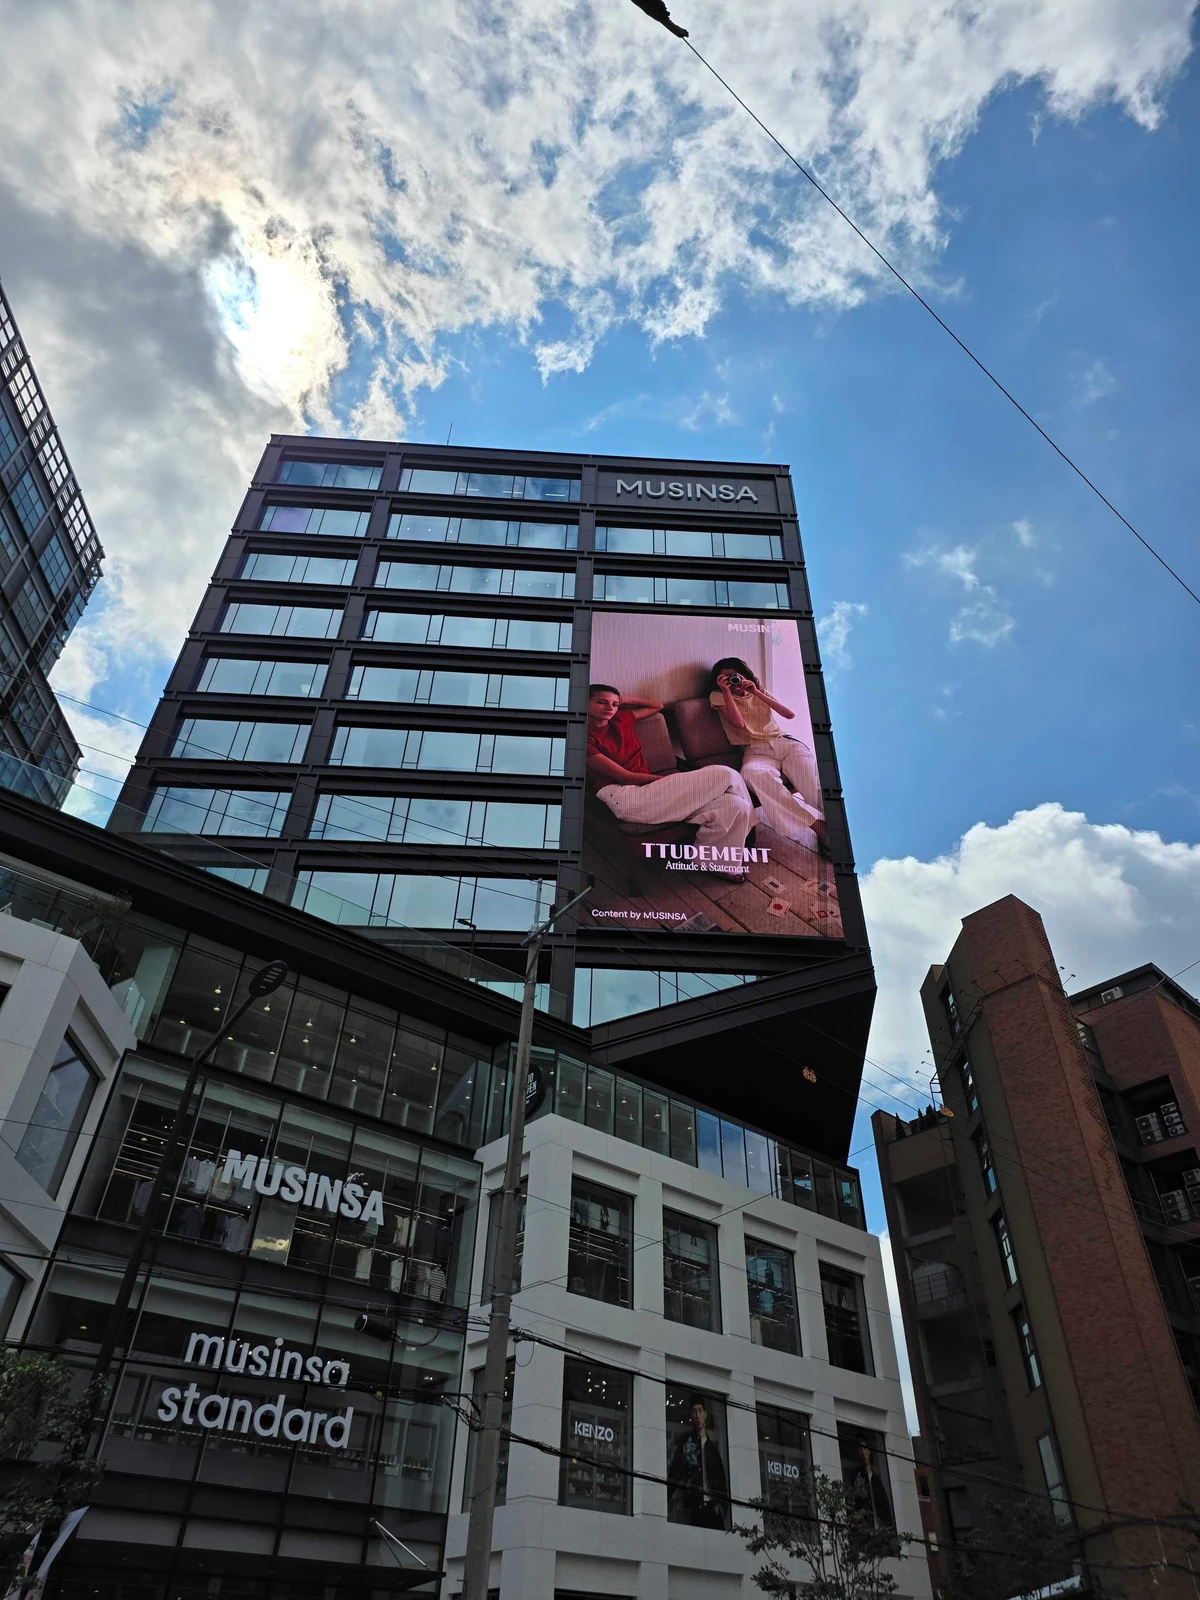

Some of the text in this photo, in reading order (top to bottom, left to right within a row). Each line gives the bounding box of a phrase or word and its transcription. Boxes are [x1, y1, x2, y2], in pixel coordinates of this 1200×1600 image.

[616, 479, 758, 503] MUSINSA
[641, 842, 772, 863] TTUDEMENT
[665, 860, 750, 873] Attitude & Statement
[591, 904, 688, 921] Content by MUSINSA
[220, 1148, 385, 1227] MUSINSA
[184, 1331, 351, 1393] musinsa
[157, 1382, 354, 1449] standard
[574, 1420, 614, 1442] KENZO
[767, 1460, 799, 1479] KENZO
